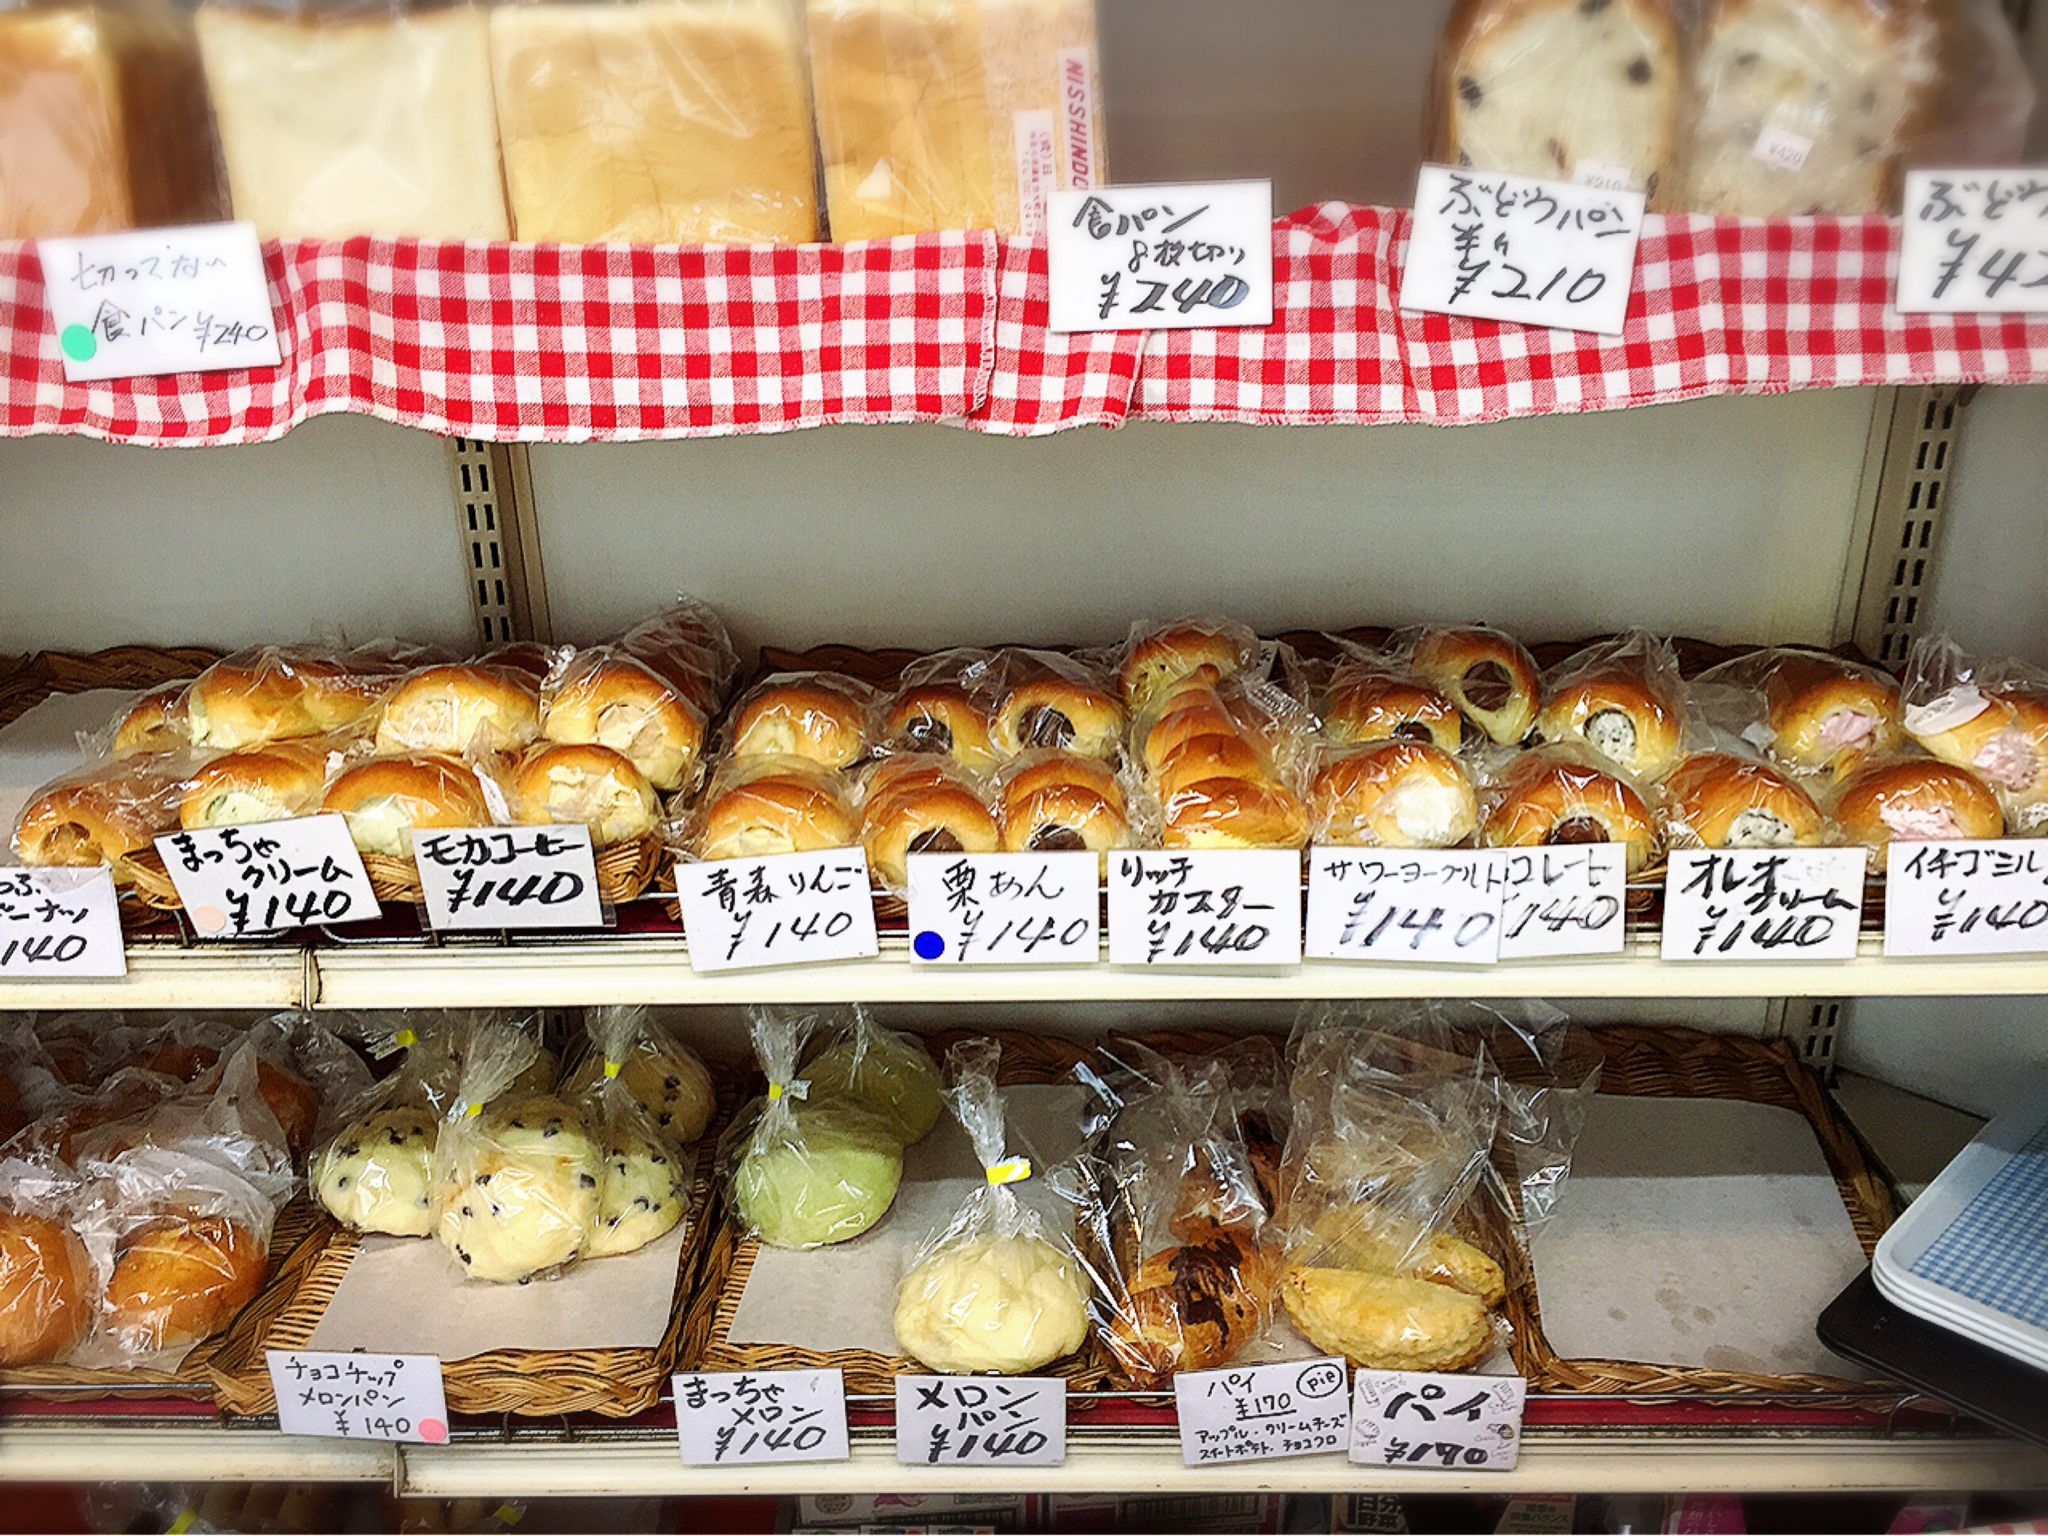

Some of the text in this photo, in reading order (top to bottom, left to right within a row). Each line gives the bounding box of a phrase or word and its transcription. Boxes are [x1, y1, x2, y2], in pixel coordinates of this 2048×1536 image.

[1072, 196, 1210, 240] 食パン
[1439, 173, 1631, 237] ぶどうパン
[1098, 271, 1250, 319] ¥240
[1448, 259, 1606, 305] ¥210
[91, 299, 269, 352] 食パン ¥240
[172, 828, 281, 872] まっちゃ
[421, 833, 585, 866] モカコーヒー
[1504, 848, 1612, 887] コレート
[1904, 846, 2048, 880] イチゴミル
[241, 856, 353, 889] クリーム
[447, 868, 584, 913] ¥140
[701, 865, 863, 912] 青森りんご
[942, 858, 1064, 912] 栗あん
[1121, 857, 1193, 886] リッチ
[1323, 859, 1502, 894] サワーヨーグルト
[1682, 854, 1789, 898] オレオ
[225, 888, 352, 935] ¥140
[1148, 887, 1275, 918] カスター
[1339, 890, 1495, 947] ¥140
[1502, 892, 1620, 939] 140
[1743, 888, 1859, 916] クリーム
[1931, 888, 2048, 941] ¥140
[726, 910, 852, 961] ¥140
[957, 910, 1089, 962] ¥140
[1146, 922, 1270, 964] ¥140
[1693, 906, 1835, 954] ¥140
[285, 1356, 404, 1387] チョコチップ
[1207, 1371, 1256, 1397] パイ
[1307, 1371, 1335, 1393] pie
[298, 1387, 405, 1408] メロンパン
[683, 1376, 785, 1408] まっちゃ
[917, 1380, 1040, 1411] メロン
[1234, 1393, 1292, 1417] ¥170
[1384, 1384, 1491, 1421] パイ
[333, 1409, 411, 1437] ¥140
[731, 1406, 824, 1426] メロン
[957, 1410, 1040, 1433] パン
[714, 1426, 827, 1461] ¥140
[928, 1423, 1048, 1462] ¥140
